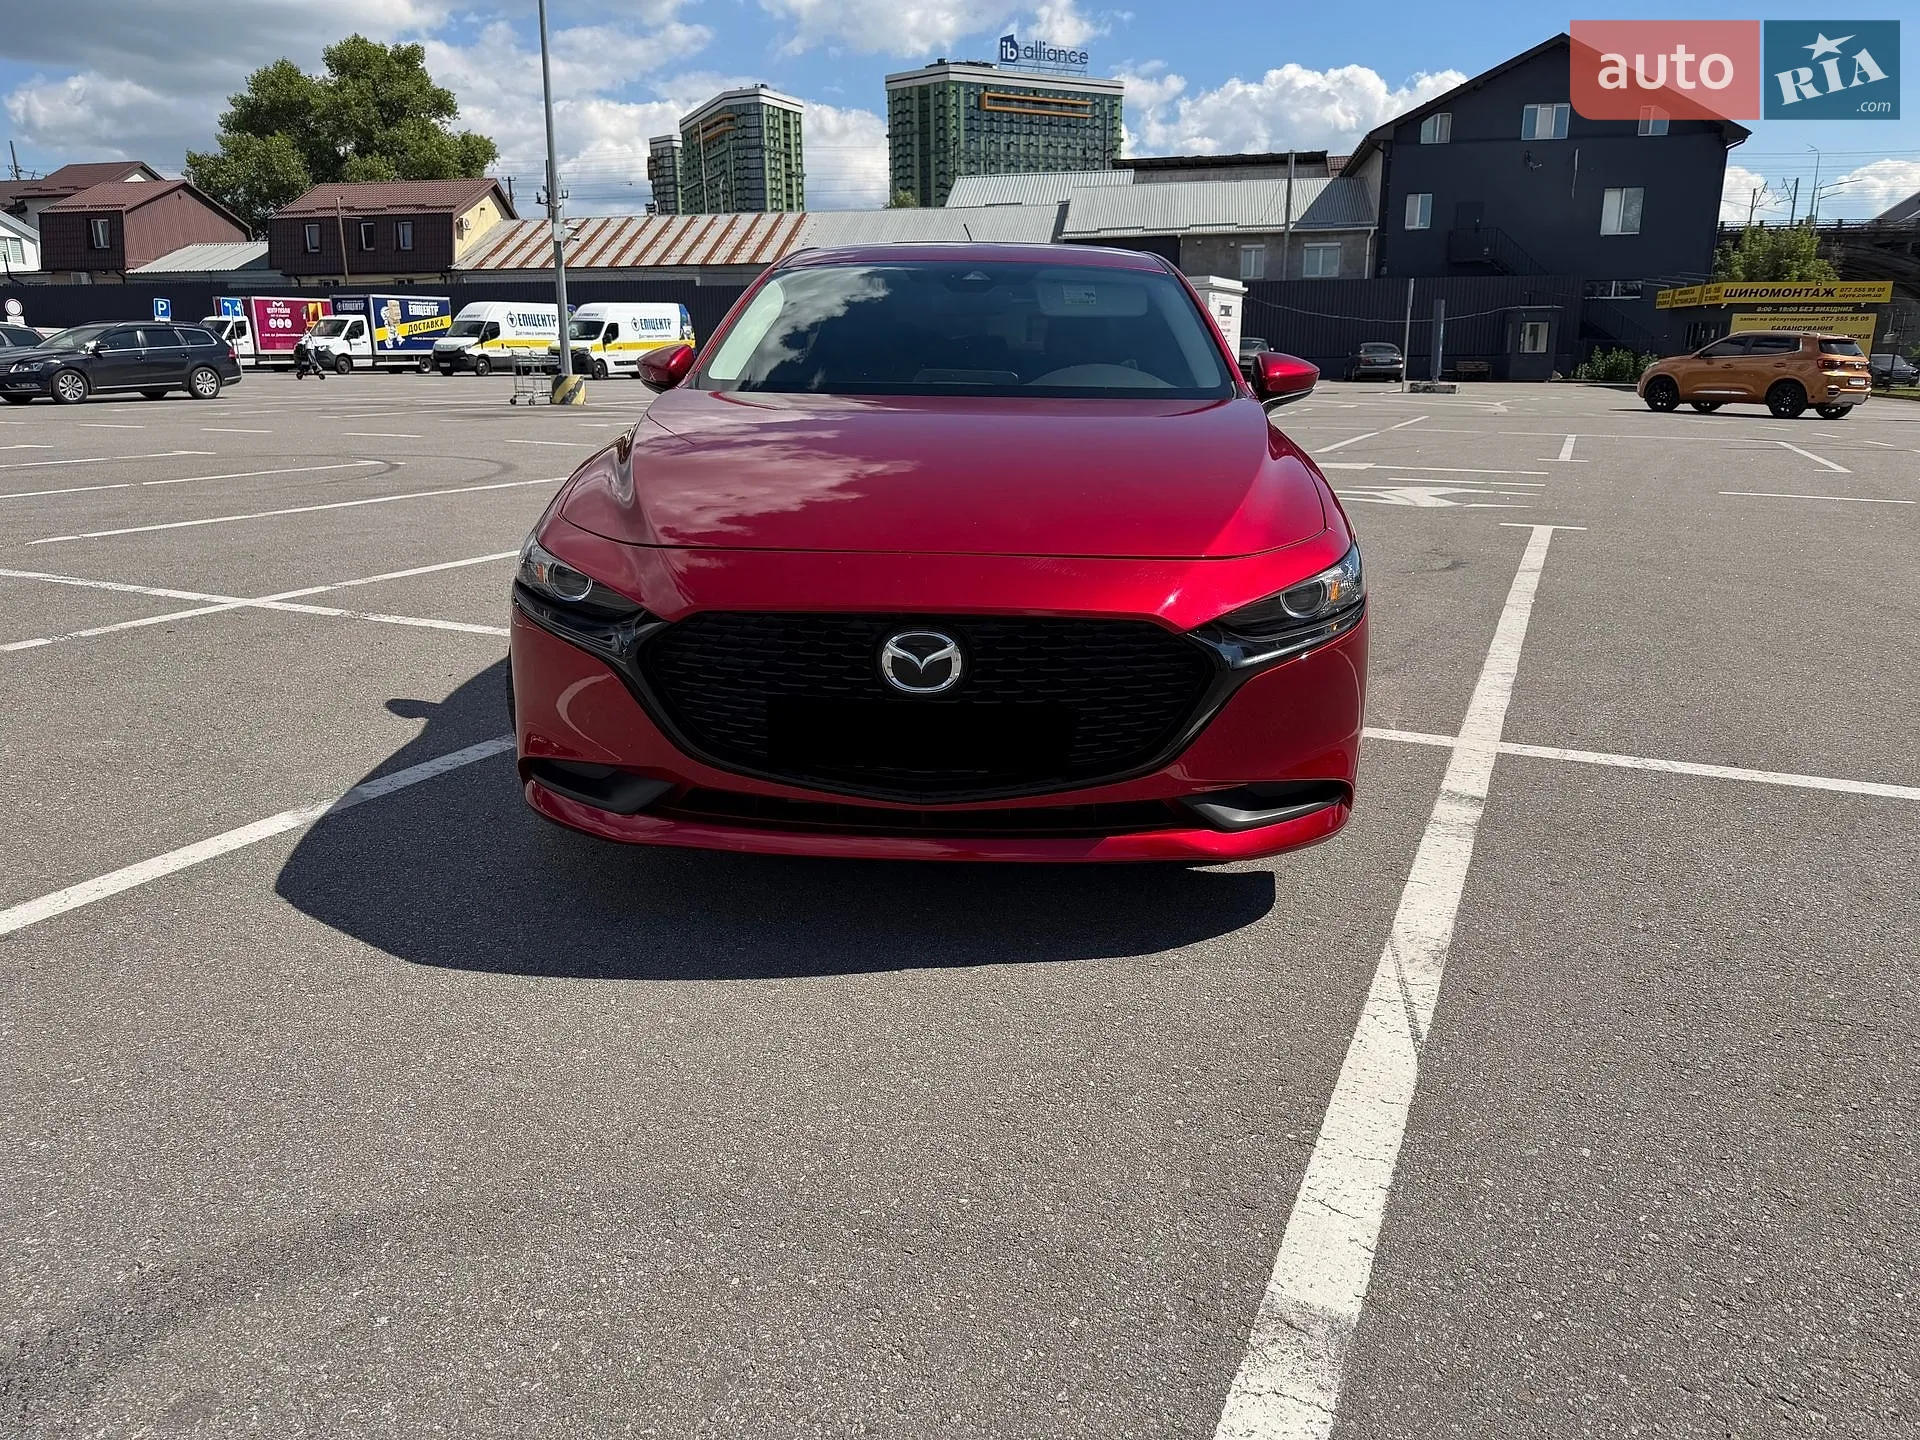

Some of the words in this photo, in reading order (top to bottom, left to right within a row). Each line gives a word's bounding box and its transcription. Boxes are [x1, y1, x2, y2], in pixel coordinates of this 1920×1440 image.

[1001, 41, 1018, 60] ib
[1023, 40, 1088, 64] alliance
[1724, 287, 1837, 298] ШИНОМОНТАЖ
[157, 301, 167, 315] P
[408, 318, 444, 335] ДОСТАВКА
[517, 313, 557, 328] ЕПІЦЕНТР
[639, 318, 671, 331] ЕПІЦЕНТР
